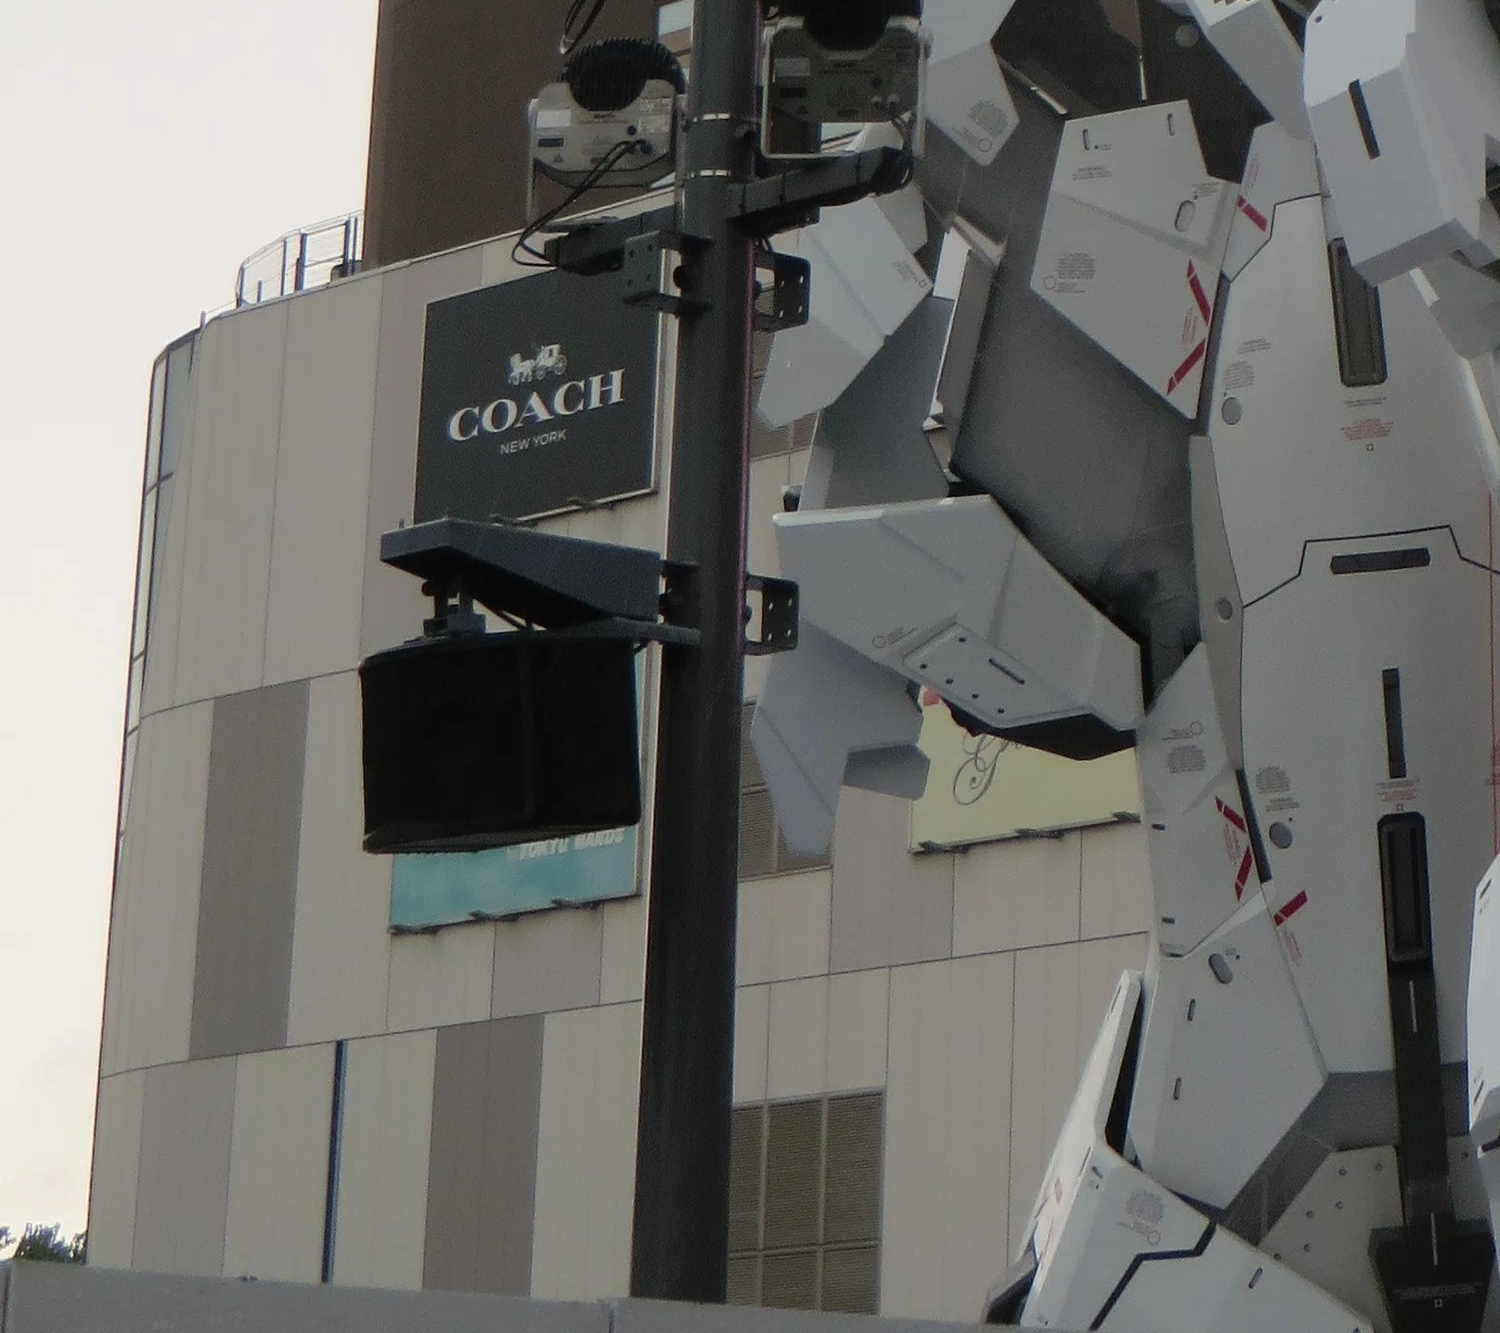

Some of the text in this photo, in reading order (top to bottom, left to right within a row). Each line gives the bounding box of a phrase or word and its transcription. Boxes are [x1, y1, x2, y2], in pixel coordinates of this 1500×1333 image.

[449, 368, 626, 442] COACH
[500, 429, 567, 455] NEW YORK
